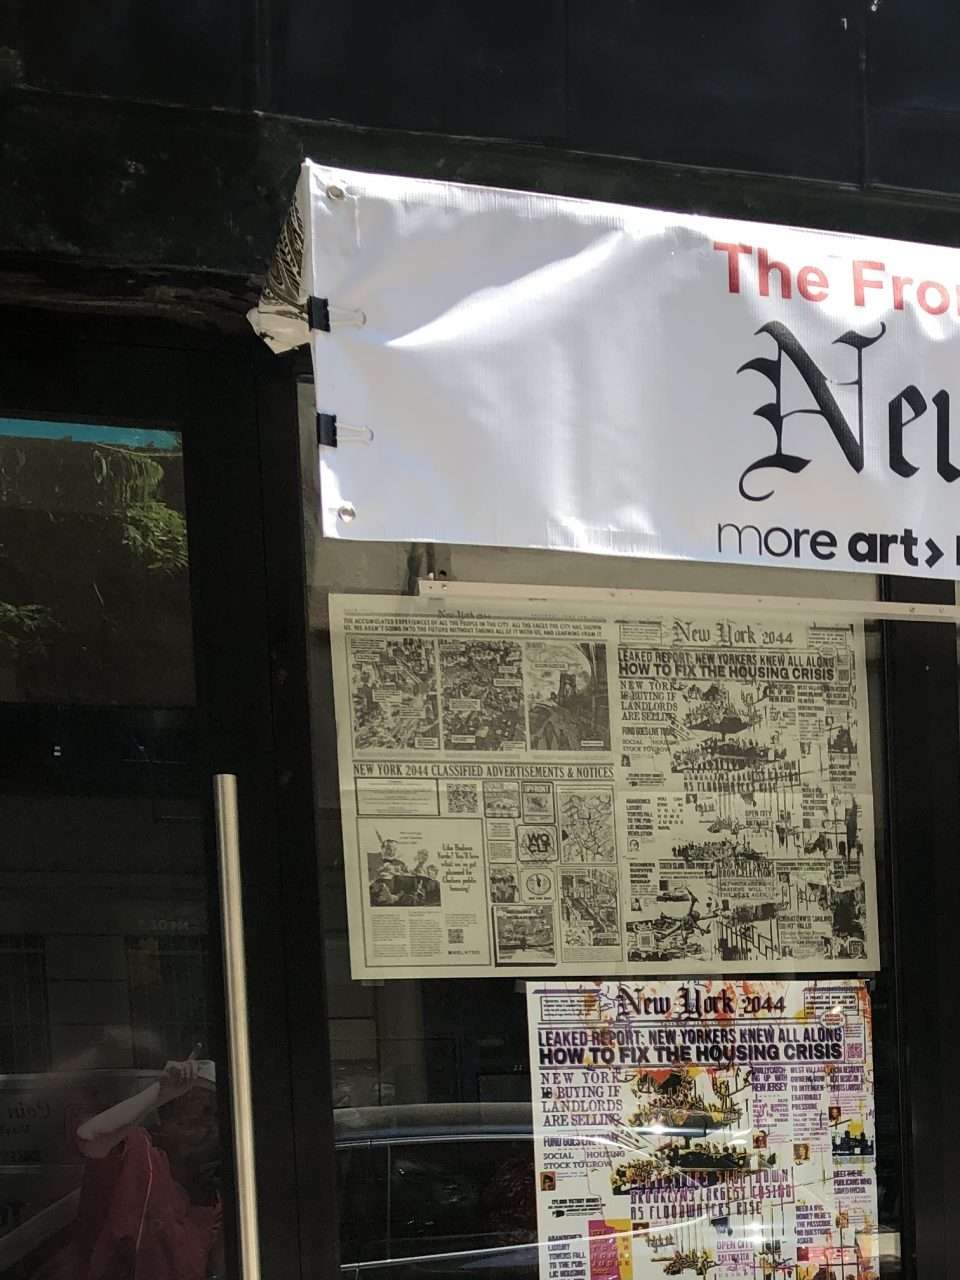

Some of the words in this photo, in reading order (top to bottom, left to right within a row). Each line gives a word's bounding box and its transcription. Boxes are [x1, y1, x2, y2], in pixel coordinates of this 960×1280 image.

[713, 242, 829, 303] The
[717, 522, 837, 560] more
[673, 621, 710, 648] New
[716, 622, 757, 647] York
[762, 632, 794, 645] 2044
[619, 662, 651, 675] HOW
[653, 663, 670, 676] TO
[675, 664, 697, 677] FIX
[699, 665, 726, 678] THE
[729, 665, 789, 680] HOUSING
[791, 667, 835, 681] CRISIS
[354, 763, 373, 776] NEW
[377, 763, 402, 776] YORK
[405, 764, 429, 777] 2044
[431, 764, 483, 778] CLASSIFIED
[486, 765, 562, 779] ADVERTISEMENTS
[576, 766, 615, 779] NOTICES
[615, 984, 670, 1021] New
[677, 985, 735, 1019] York
[741, 995, 786, 1014] 2044
[538, 1030, 588, 1047] LEAKED
[591, 1029, 645, 1046] REPORT:
[649, 1029, 676, 1045] NEW
[679, 1028, 737, 1044] YORKERS
[739, 1027, 776, 1044] KNEW
[778, 1027, 800, 1043] ALL
[803, 1026, 842, 1043] ALONG
[539, 1047, 584, 1065] HOW
[589, 1047, 615, 1064] TO
[619, 1047, 649, 1063] FIX
[653, 1046, 692, 1063] THE
[697, 1044, 780, 1062] HOUSING
[783, 1042, 842, 1061] CRISIS
[541, 1072, 574, 1085] NEW
[582, 1071, 620, 1084] YORK
[557, 1085, 604, 1099] BUYING
[608, 1085, 621, 1098] IF
[542, 1099, 623, 1113] LANDLORDS
[543, 1114, 569, 1127] ARE
[571, 1113, 622, 1126] SELLING
[543, 1152, 574, 1160] SOCIAL
[543, 1161, 571, 1169] STOCK
